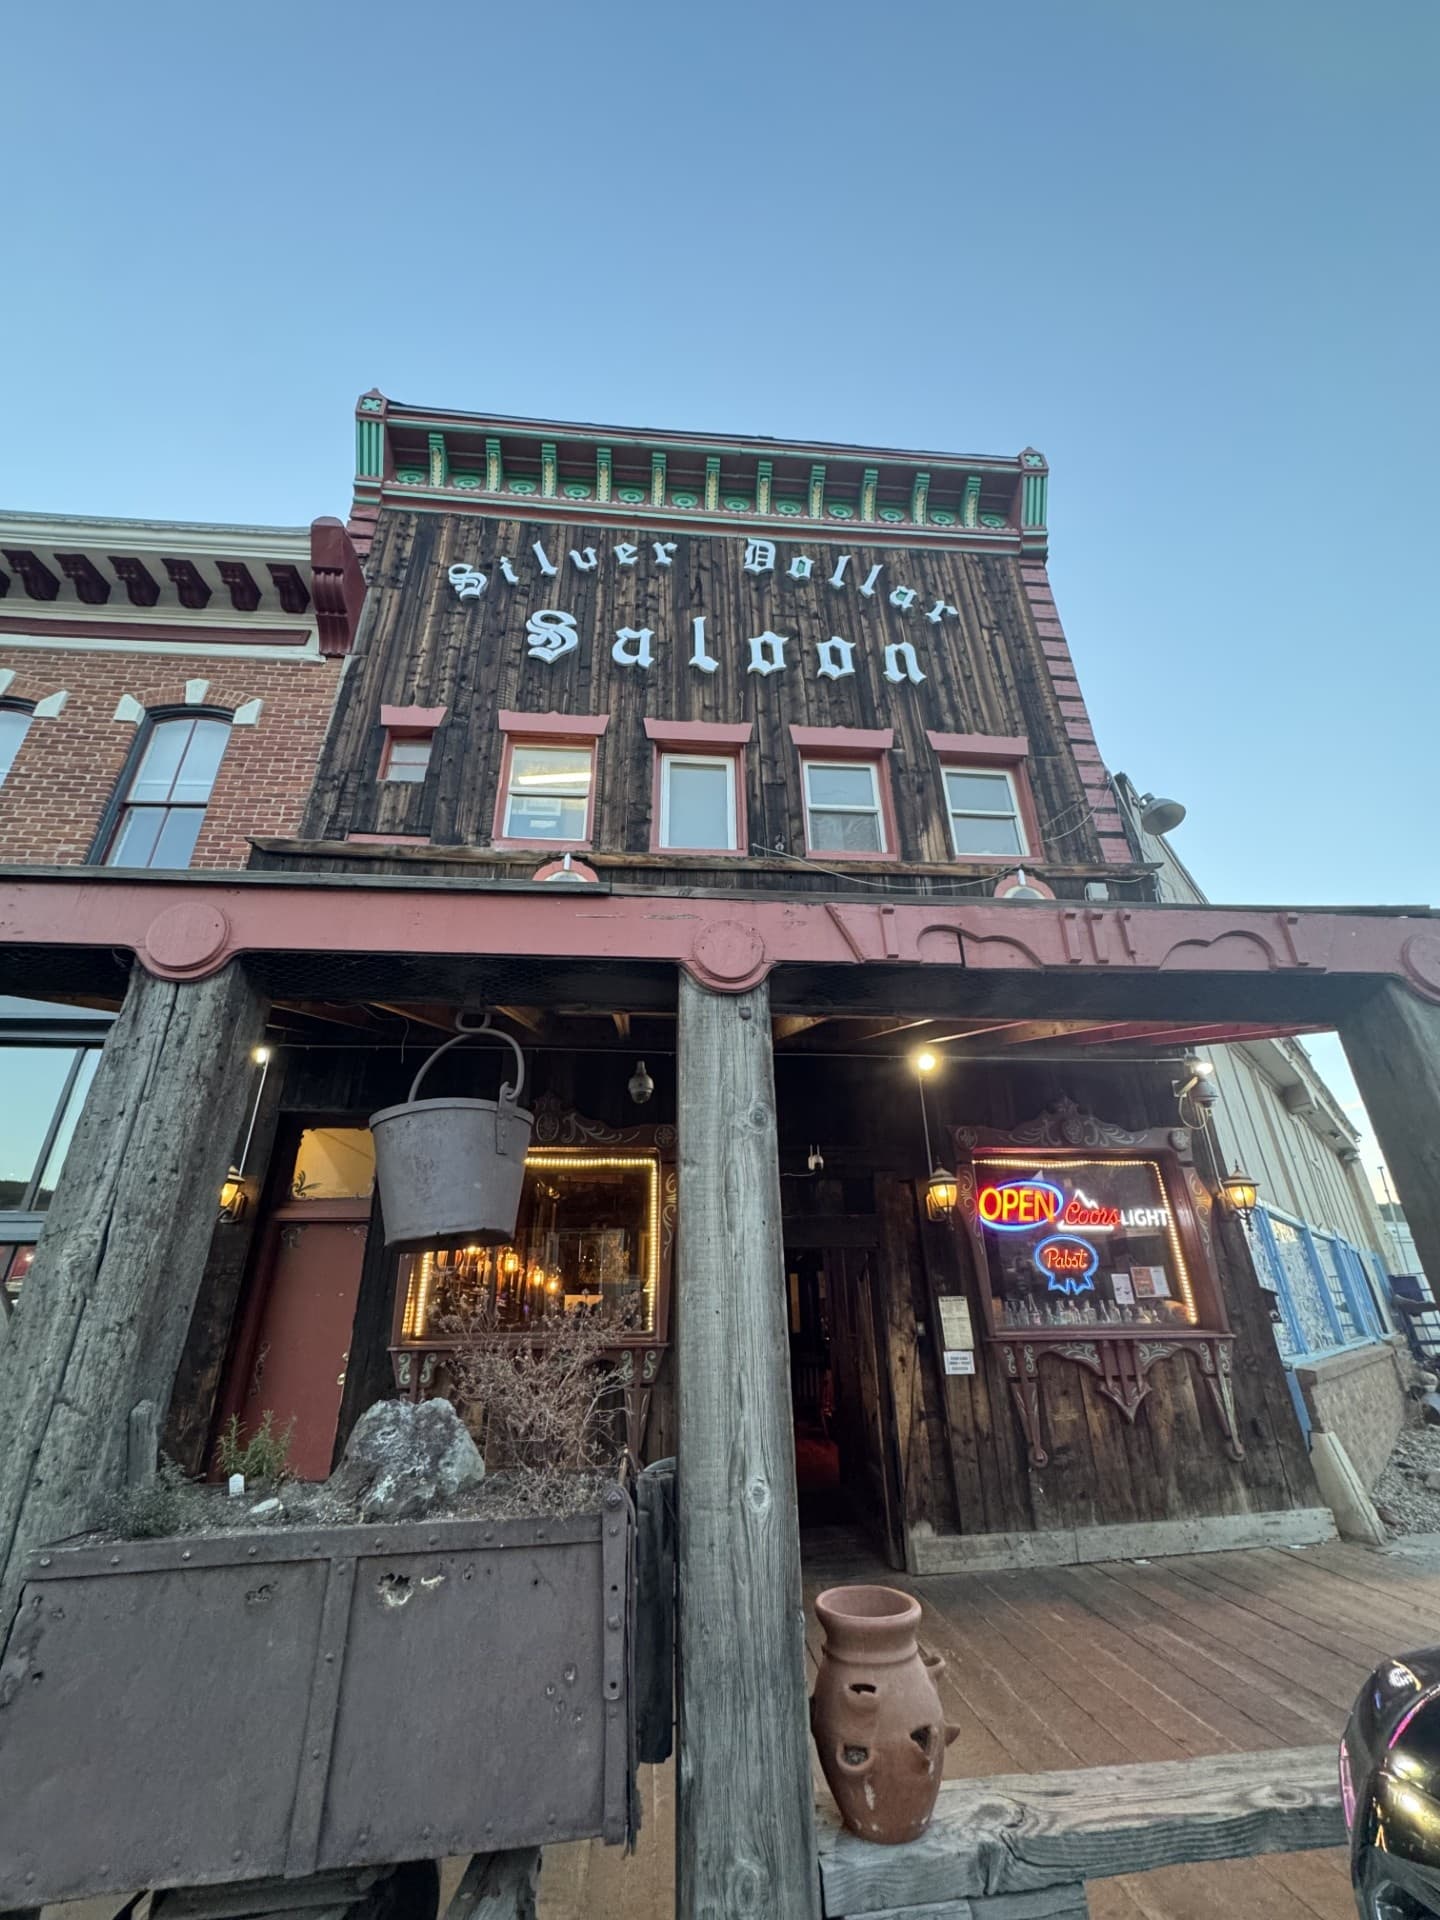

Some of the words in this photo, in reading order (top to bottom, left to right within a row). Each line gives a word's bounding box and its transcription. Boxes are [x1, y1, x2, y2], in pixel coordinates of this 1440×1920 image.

[448, 540, 678, 600] Silver
[744, 538, 959, 623] Dollar
[526, 609, 927, 686] Saloon
[978, 1186, 1055, 1223] OPEN
[1065, 1201, 1119, 1226] Coors
[1120, 1208, 1168, 1227] LIGHT
[1044, 1247, 1088, 1269] Pabst
